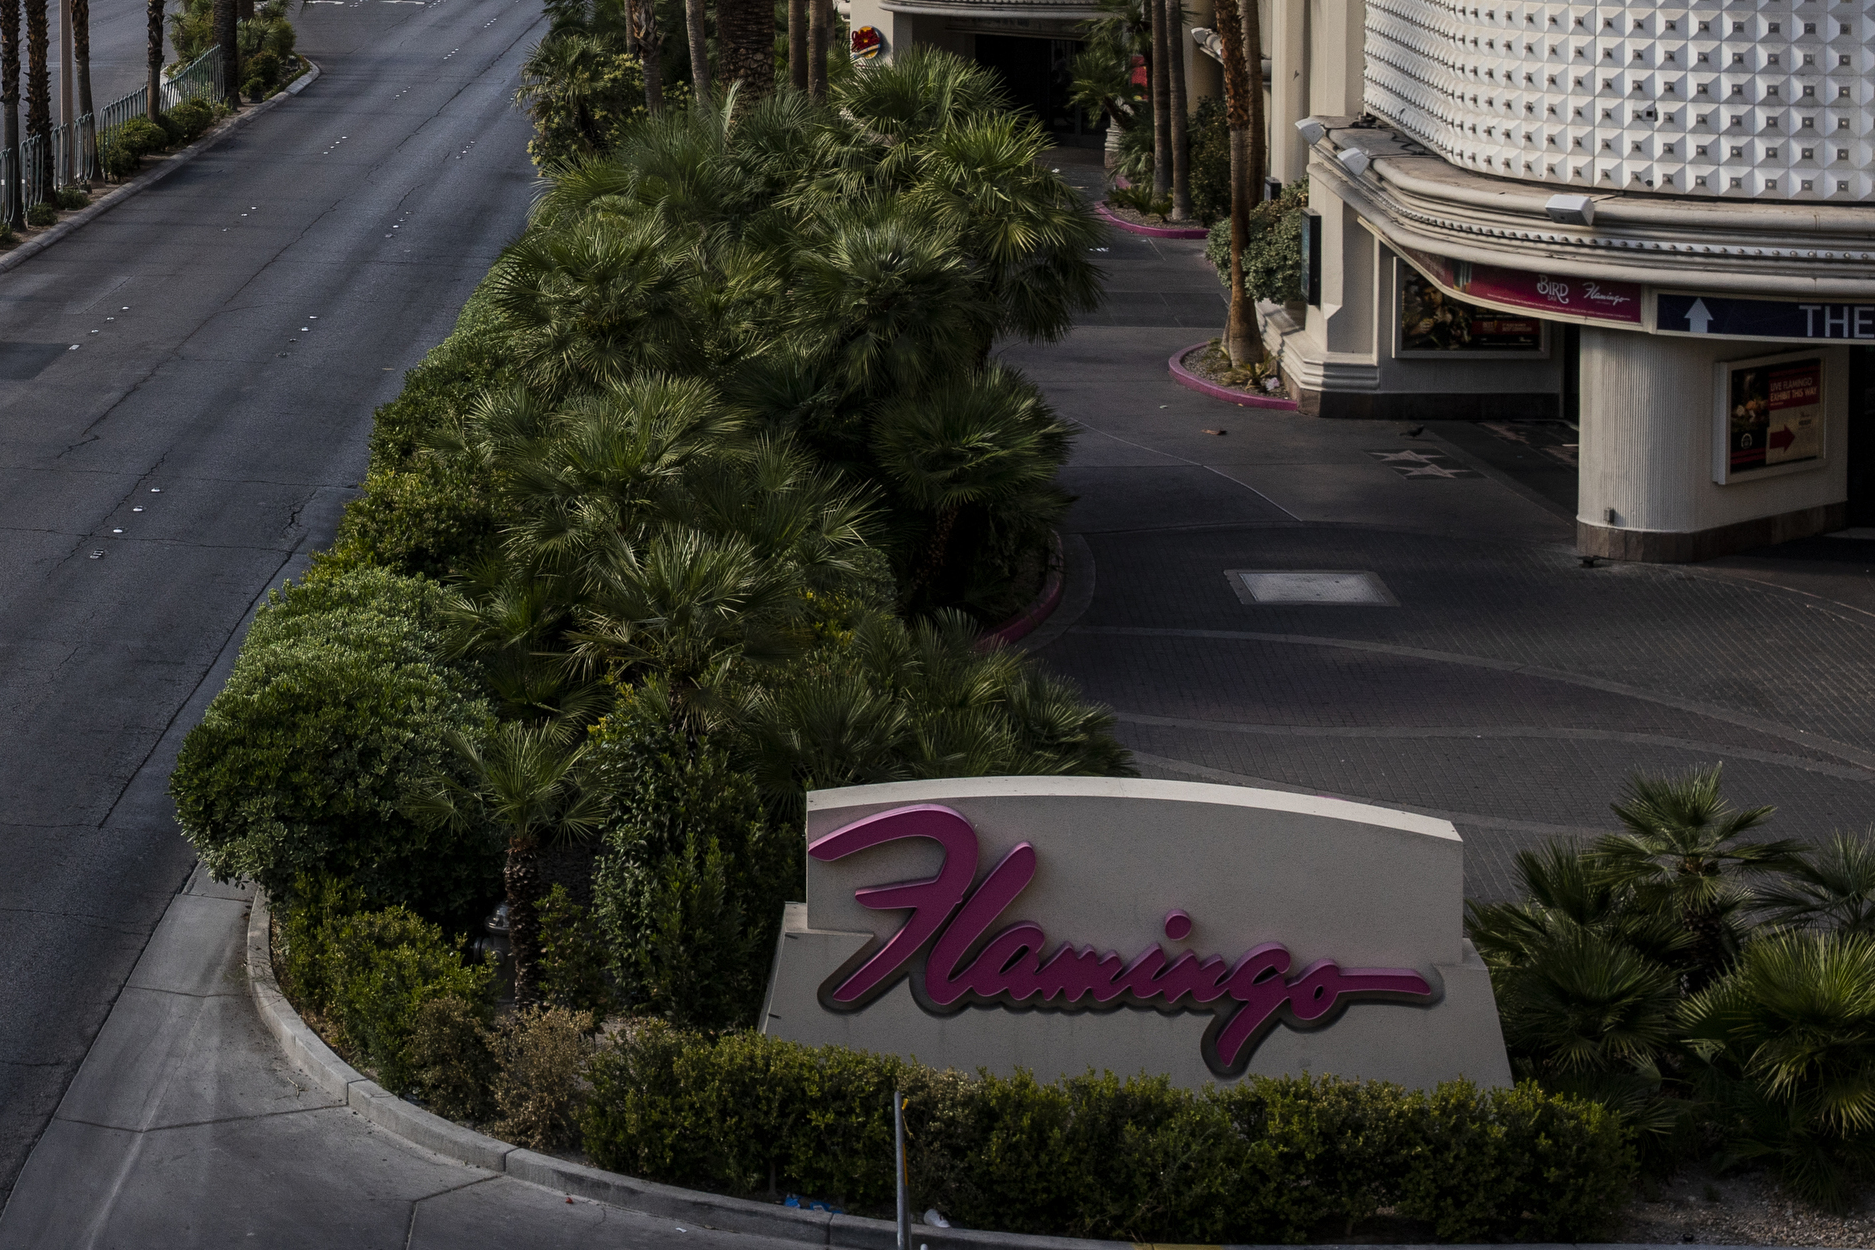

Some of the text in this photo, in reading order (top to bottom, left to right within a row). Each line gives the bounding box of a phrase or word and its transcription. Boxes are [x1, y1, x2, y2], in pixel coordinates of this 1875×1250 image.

[1537, 274, 1631, 306] BIRD Flamingo
[1798, 305, 1875, 338] THE
[1770, 387, 1817, 402] EXHIBIT THIS WAY
[808, 803, 1431, 1066] Flamingo
